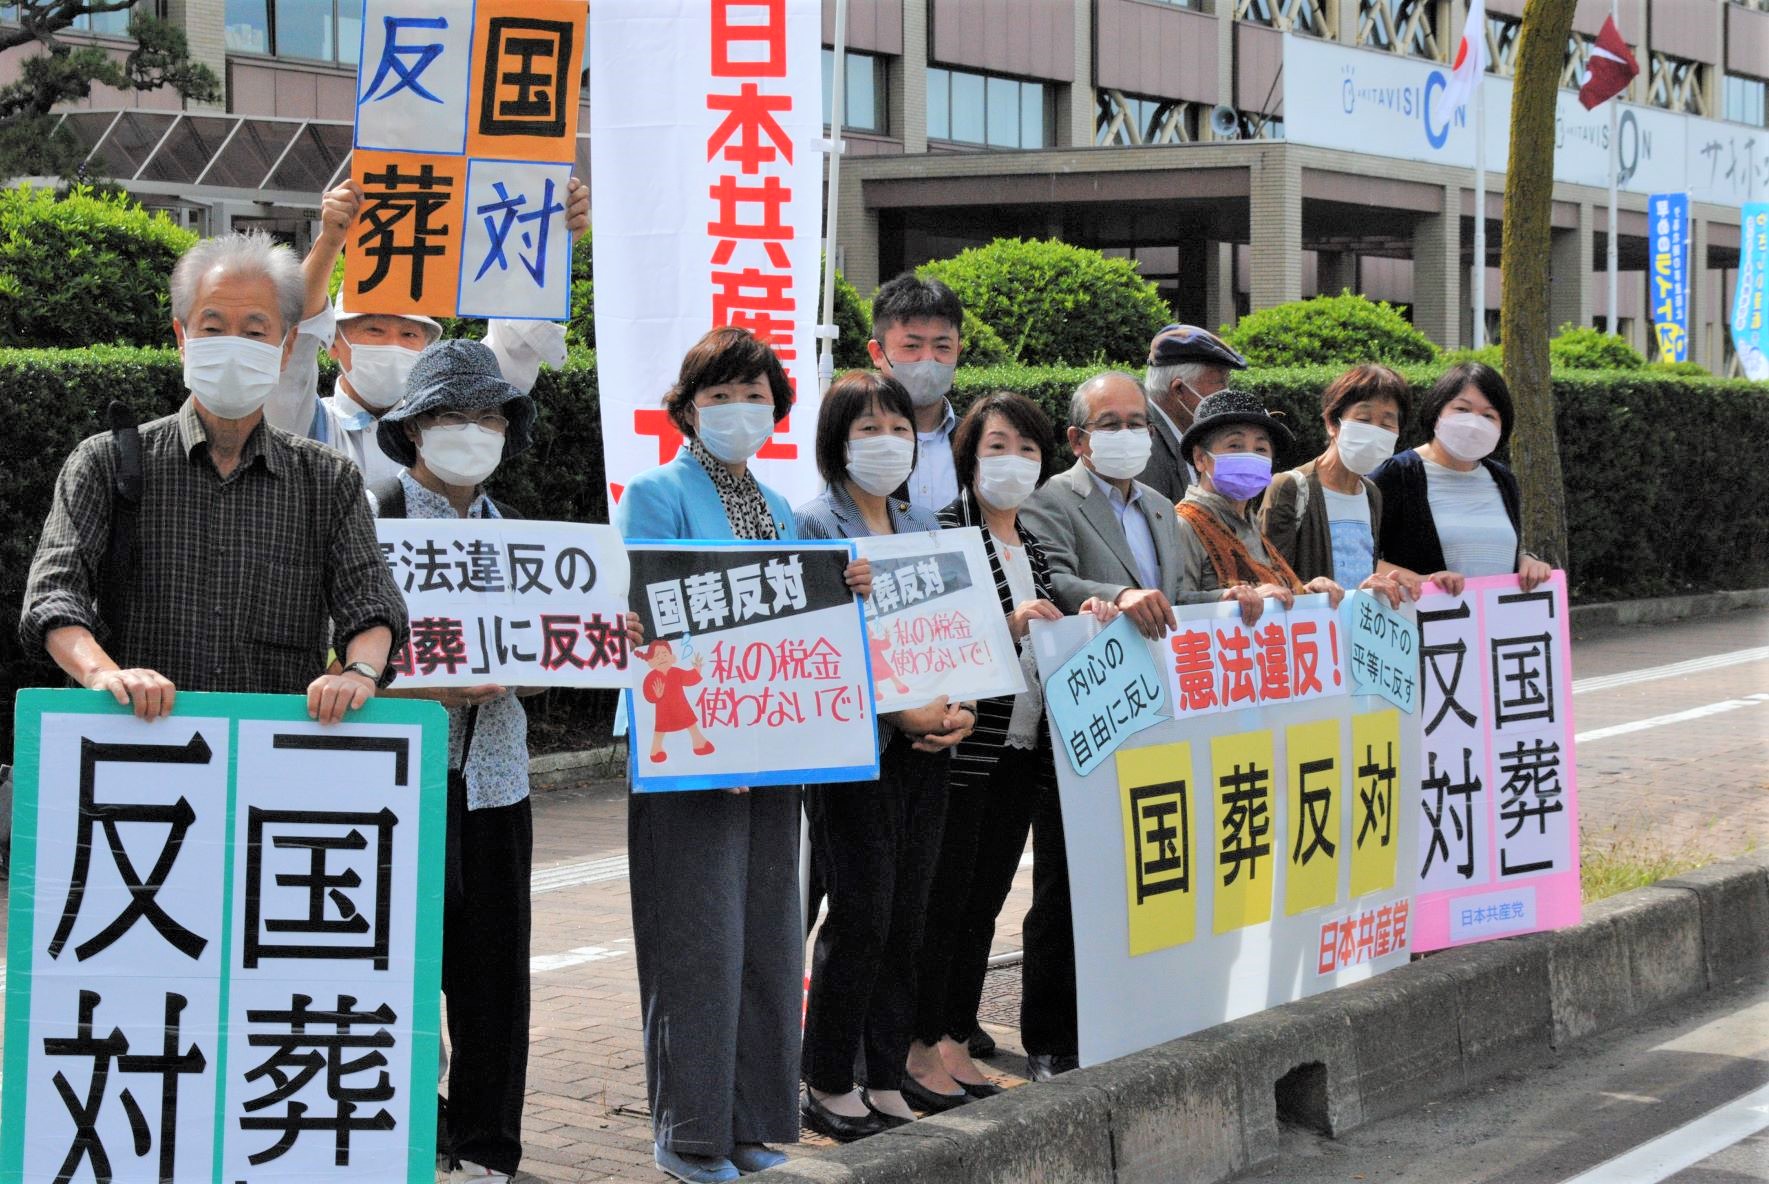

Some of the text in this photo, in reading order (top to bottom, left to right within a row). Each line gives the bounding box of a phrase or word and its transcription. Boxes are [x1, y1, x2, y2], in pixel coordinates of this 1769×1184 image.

[707, 0, 798, 460] 日本共産
[646, 554, 807, 638] 国葬反対
[894, 611, 973, 646] 私の税金
[1359, 602, 1412, 656] 法の下の
[709, 637, 842, 684] 私の税金
[891, 640, 993, 677] 使わないで!
[1067, 638, 1124, 706] 内心の
[1171, 620, 1342, 711] 憲法違反!
[1353, 643, 1415, 704] 平等に反す
[696, 685, 865, 729] 使わないで!
[1070, 674, 1160, 767] 自由に反し
[1417, 599, 1482, 880] 反対
[1129, 741, 1396, 905] 国葬反対
[1318, 899, 1409, 975] 日本共産党
[1461, 901, 1524, 926] 日本共産党
[43, 731, 213, 1184] 反対
[238, 733, 410, 1184] 「国葬
